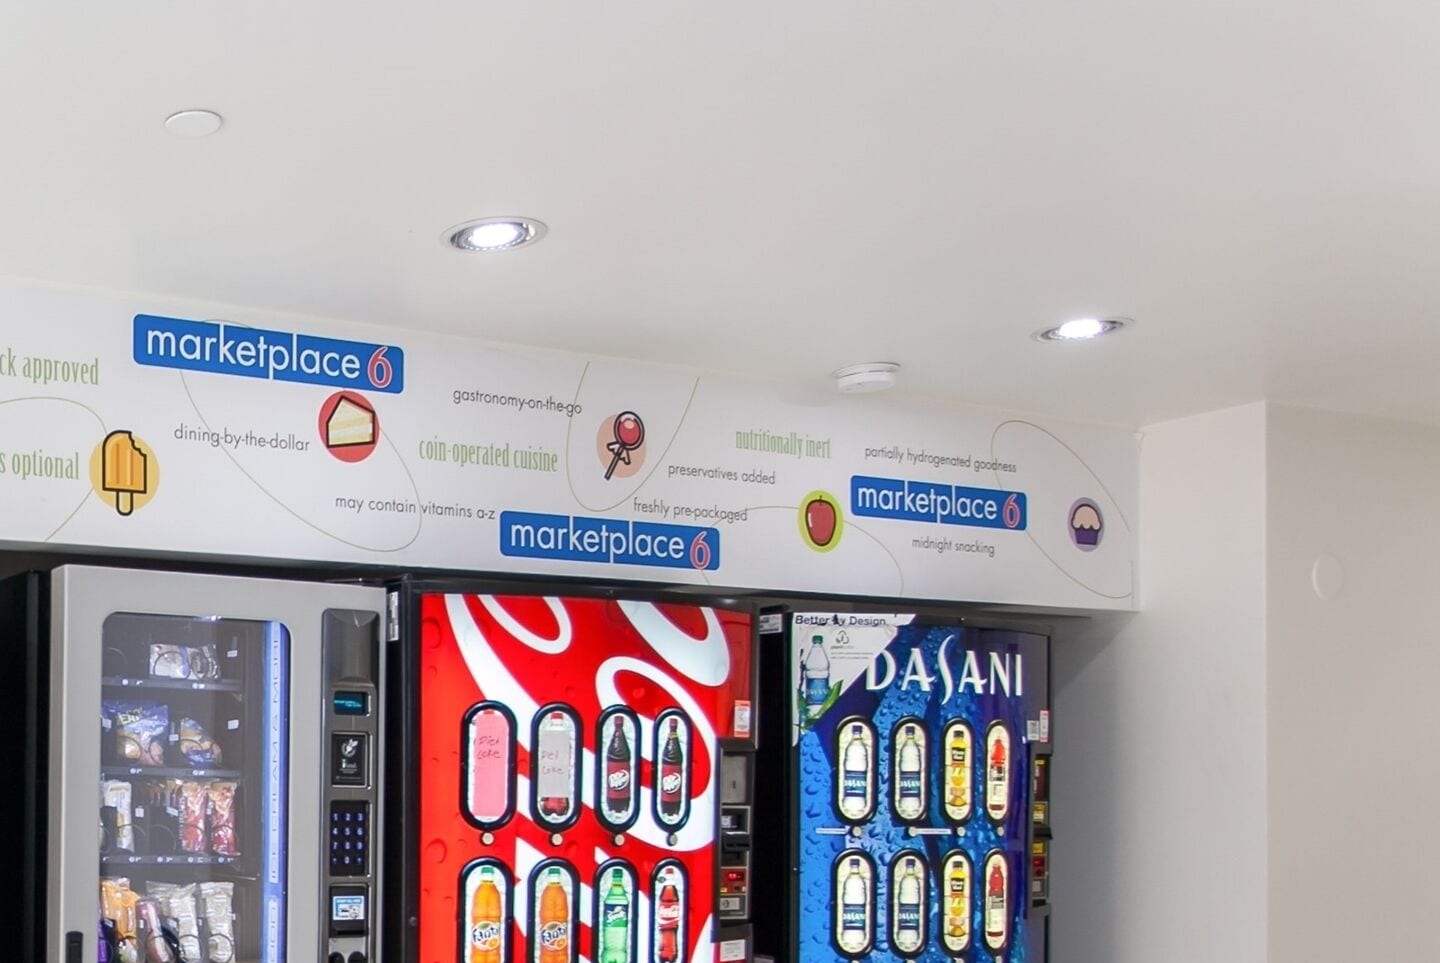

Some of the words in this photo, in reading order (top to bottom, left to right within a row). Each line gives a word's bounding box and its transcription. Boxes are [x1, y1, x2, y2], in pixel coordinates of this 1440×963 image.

[146, 323, 361, 380] marketplace
[367, 346, 393, 389] 6
[22, 357, 100, 386] approved
[453, 389, 582, 417] gastronomy-on-the-go
[174, 423, 310, 451] dining-by-the-dollar
[736, 428, 803, 458] nutritionally
[806, 437, 831, 459] inert
[11, 451, 79, 480] optional
[419, 436, 511, 468] coin-operated
[513, 447, 558, 472] cuisine
[864, 446, 903, 463] partially
[907, 448, 971, 469] hydrogenated
[974, 457, 1017, 473] goodness
[668, 463, 738, 482] preservatives
[741, 470, 776, 485] added
[335, 495, 363, 513] may
[368, 497, 417, 515] contain
[421, 502, 473, 519] vitamins
[476, 508, 496, 520] a-z
[633, 497, 669, 518] freshly
[673, 506, 747, 524] pre-packaged
[858, 480, 997, 525] marketplace
[1002, 493, 1020, 529] 6
[511, 515, 685, 563] marketplace
[690, 531, 712, 570] 6
[912, 536, 952, 552] midnight
[955, 541, 995, 558] snacking
[795, 615, 831, 625] Better
[849, 616, 886, 627] Design
[865, 634, 1023, 706] DASANI
